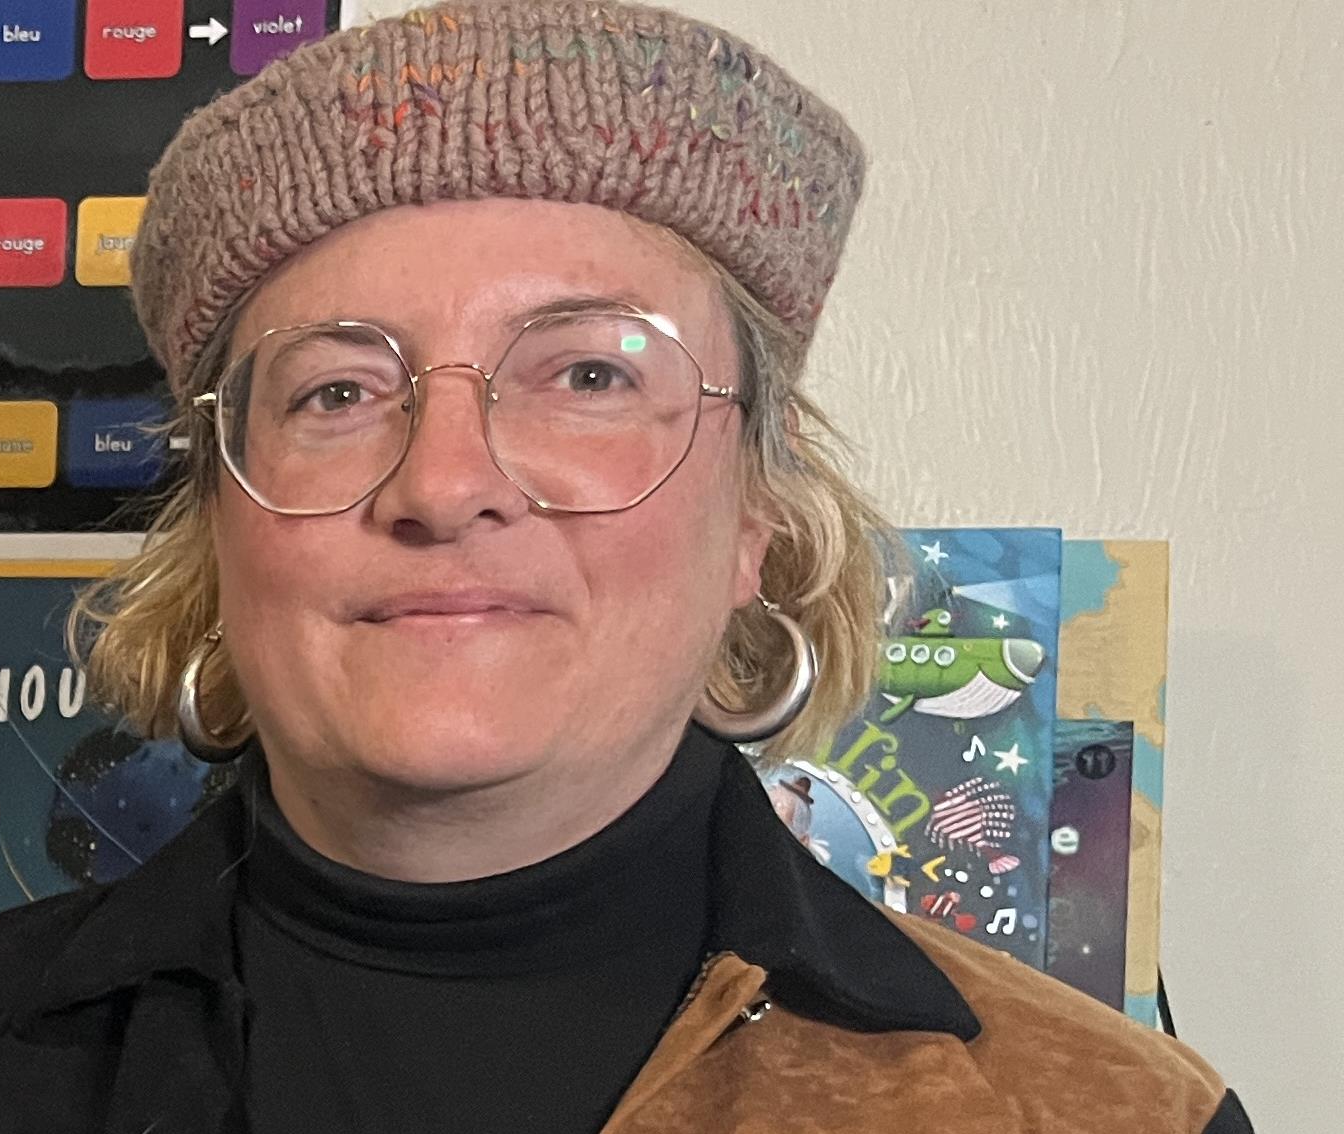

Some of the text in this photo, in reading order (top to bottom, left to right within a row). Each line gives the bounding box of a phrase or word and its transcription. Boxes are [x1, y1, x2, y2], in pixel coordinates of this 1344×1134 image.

[3, 15, 302, 43] bleu rouge violet
[94, 432, 132, 453] bleu
